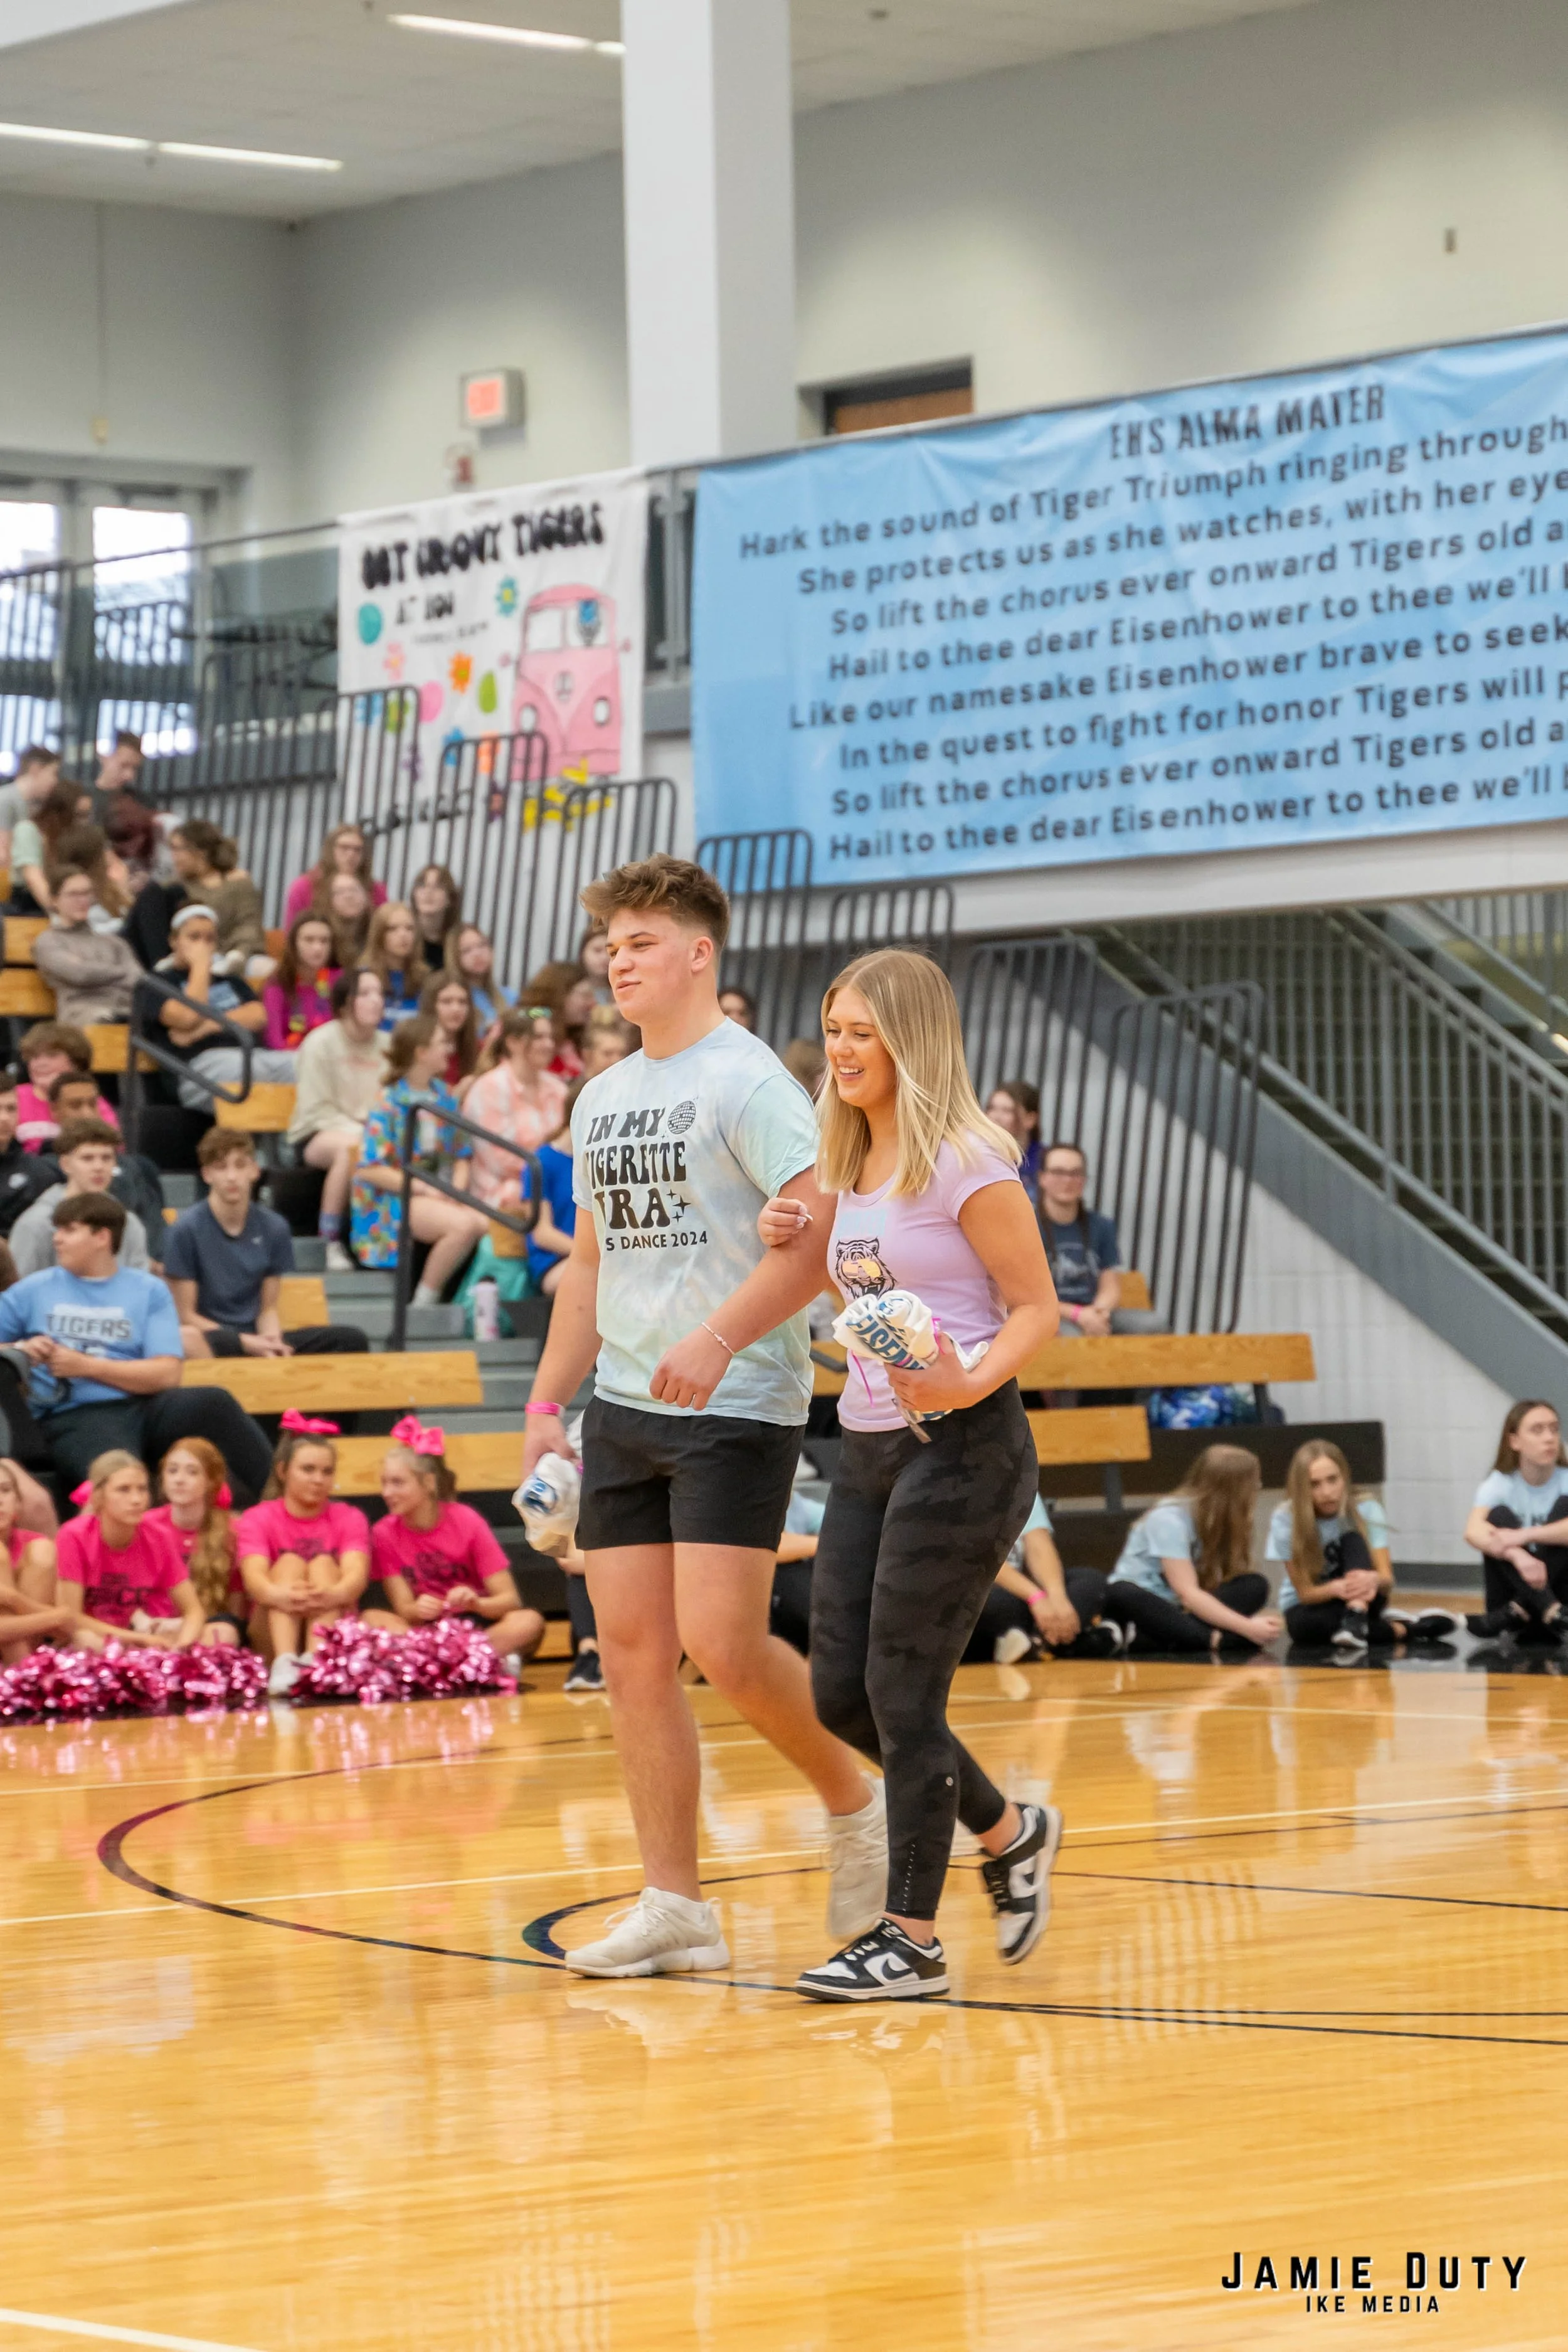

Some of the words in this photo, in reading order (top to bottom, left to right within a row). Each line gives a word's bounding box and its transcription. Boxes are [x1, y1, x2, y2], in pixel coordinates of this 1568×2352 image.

[1110, 417, 1165, 459] EHS
[1178, 405, 1262, 450] ALMA
[1275, 383, 1385, 436] MATER
[740, 527, 808, 558] Hark
[821, 520, 870, 547] the
[882, 502, 977, 538] sound
[990, 493, 1020, 522] of
[1030, 485, 1113, 521] Tiger
[1125, 460, 1266, 502] Triumph
[1279, 442, 1408, 483] ringing
[1420, 414, 1568, 461] through
[799, 567, 856, 594] She
[866, 544, 1004, 593] protects
[1016, 538, 1052, 565] us
[1066, 533, 1096, 558] as
[1108, 522, 1165, 551] she
[1179, 504, 1332, 544] watches,
[1345, 485, 1421, 520] with
[1435, 479, 1495, 509] her
[832, 610, 868, 634] So
[880, 599, 923, 630] lift
[936, 592, 988, 621] the
[1001, 577, 1108, 614] chorus
[1120, 568, 1195, 596] ever
[1209, 544, 1337, 586] onward
[1350, 533, 1464, 570] Tigers
[1479, 519, 1533, 549] old
[790, 702, 856, 729] Like
[868, 696, 917, 721] our
[929, 674, 1096, 714] namesake
[1108, 650, 1308, 691] Eisenhower
[1321, 637, 1422, 670] brave
[1435, 630, 1470, 655] to
[829, 649, 888, 680] Hail
[898, 652, 930, 671] to
[942, 637, 1012, 667] thee
[1025, 628, 1098, 657] dear
[1110, 599, 1310, 645] Eisenhower
[1322, 597, 1357, 620] to
[1371, 586, 1452, 614] thee
[840, 744, 869, 770] In
[880, 739, 928, 764] the
[942, 729, 1032, 766] quest
[1043, 724, 1076, 746] to
[1089, 710, 1167, 748] fight
[1179, 706, 1227, 731] for
[1237, 695, 1342, 725] honor
[1356, 680, 1468, 719] Tigers
[1481, 666, 1544, 701] will
[832, 790, 870, 815] So
[881, 780, 923, 811] lift
[936, 779, 990, 807] the
[1002, 765, 1108, 799] chorus
[1120, 758, 1197, 786] ever
[1212, 740, 1339, 778] onward
[1352, 729, 1466, 768] Tigers
[1481, 719, 1534, 750] old
[830, 830, 893, 860] Hail
[902, 834, 933, 854] to
[945, 818, 1018, 847] thee
[1030, 814, 1101, 843] dear
[1110, 794, 1315, 832] Eisenhower
[1327, 790, 1362, 813] to
[1377, 781, 1459, 810] thee
[586, 1113, 617, 1145] IN
[617, 1106, 665, 1138] MY
[620, 1234, 667, 1250] DANCE
[671, 1231, 708, 1248] 2024
[45, 1313, 131, 1338] TIGERS
